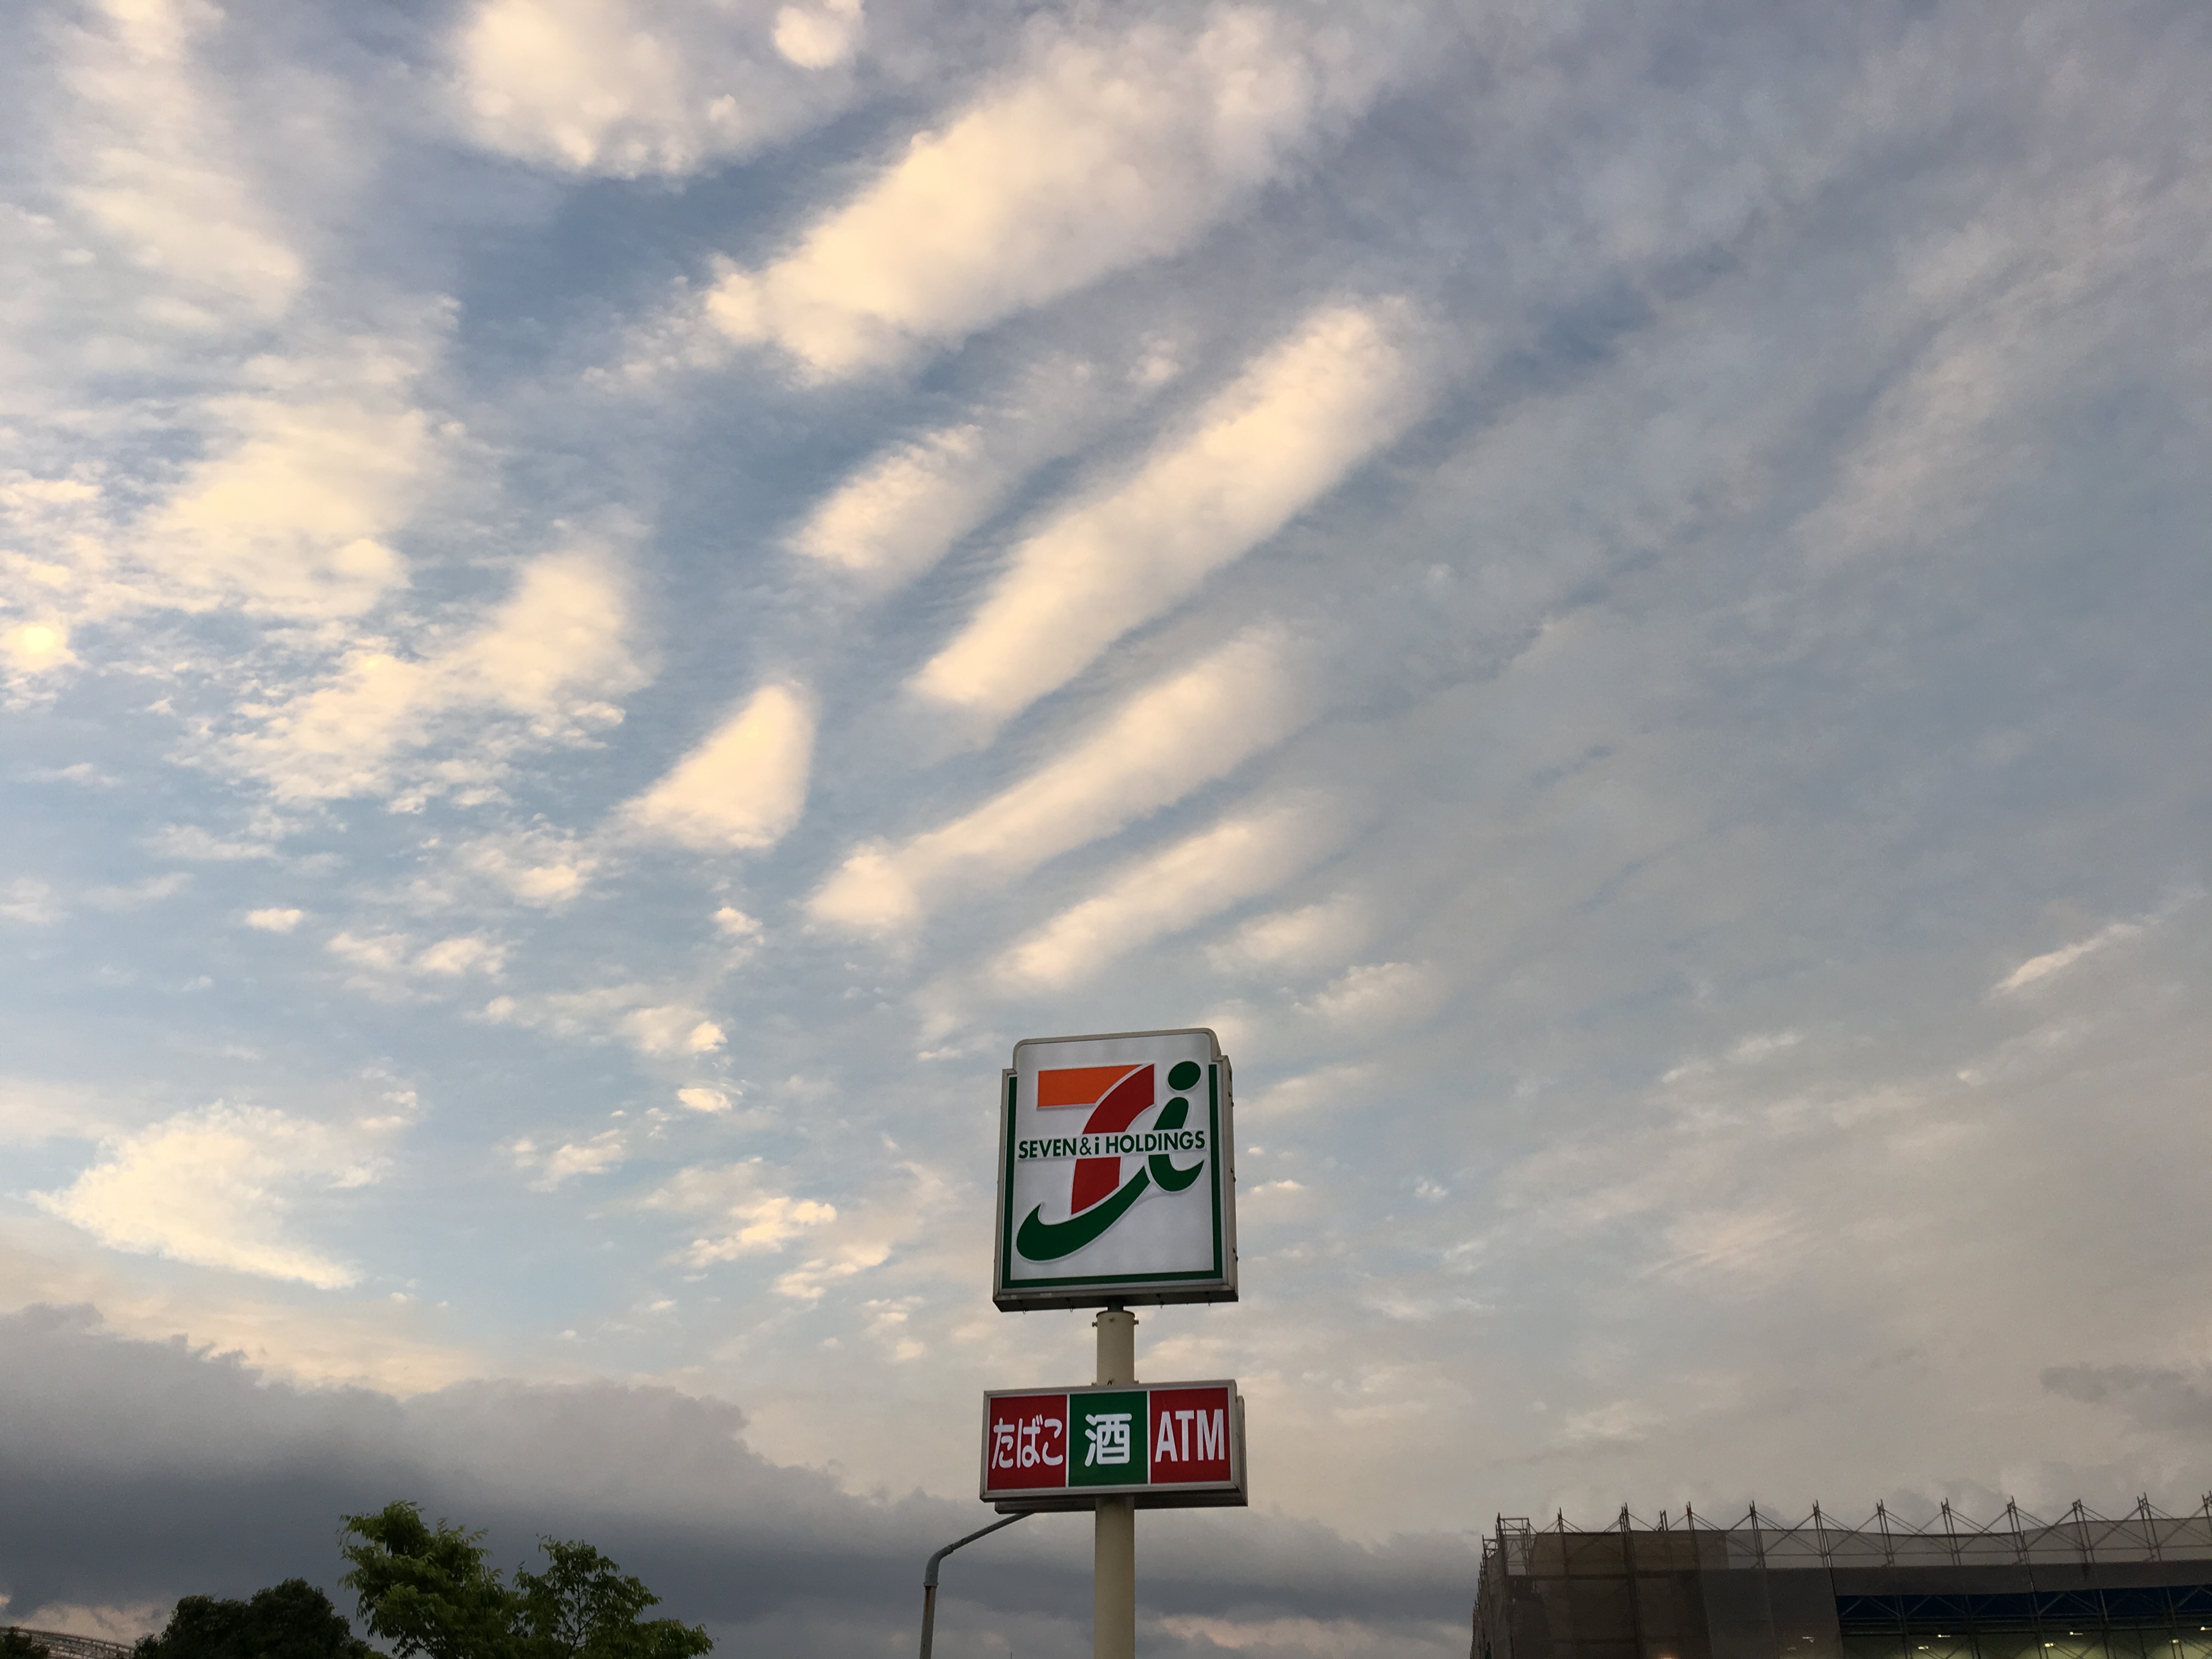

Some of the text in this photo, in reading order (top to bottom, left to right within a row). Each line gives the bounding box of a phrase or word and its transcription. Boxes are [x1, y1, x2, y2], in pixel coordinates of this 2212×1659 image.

[1105, 1130, 1206, 1154] HOLDINGS
[991, 1414, 1063, 1470] たばこ
[1084, 1413, 1132, 1467] 酒
[1155, 1408, 1225, 1463] ATM
